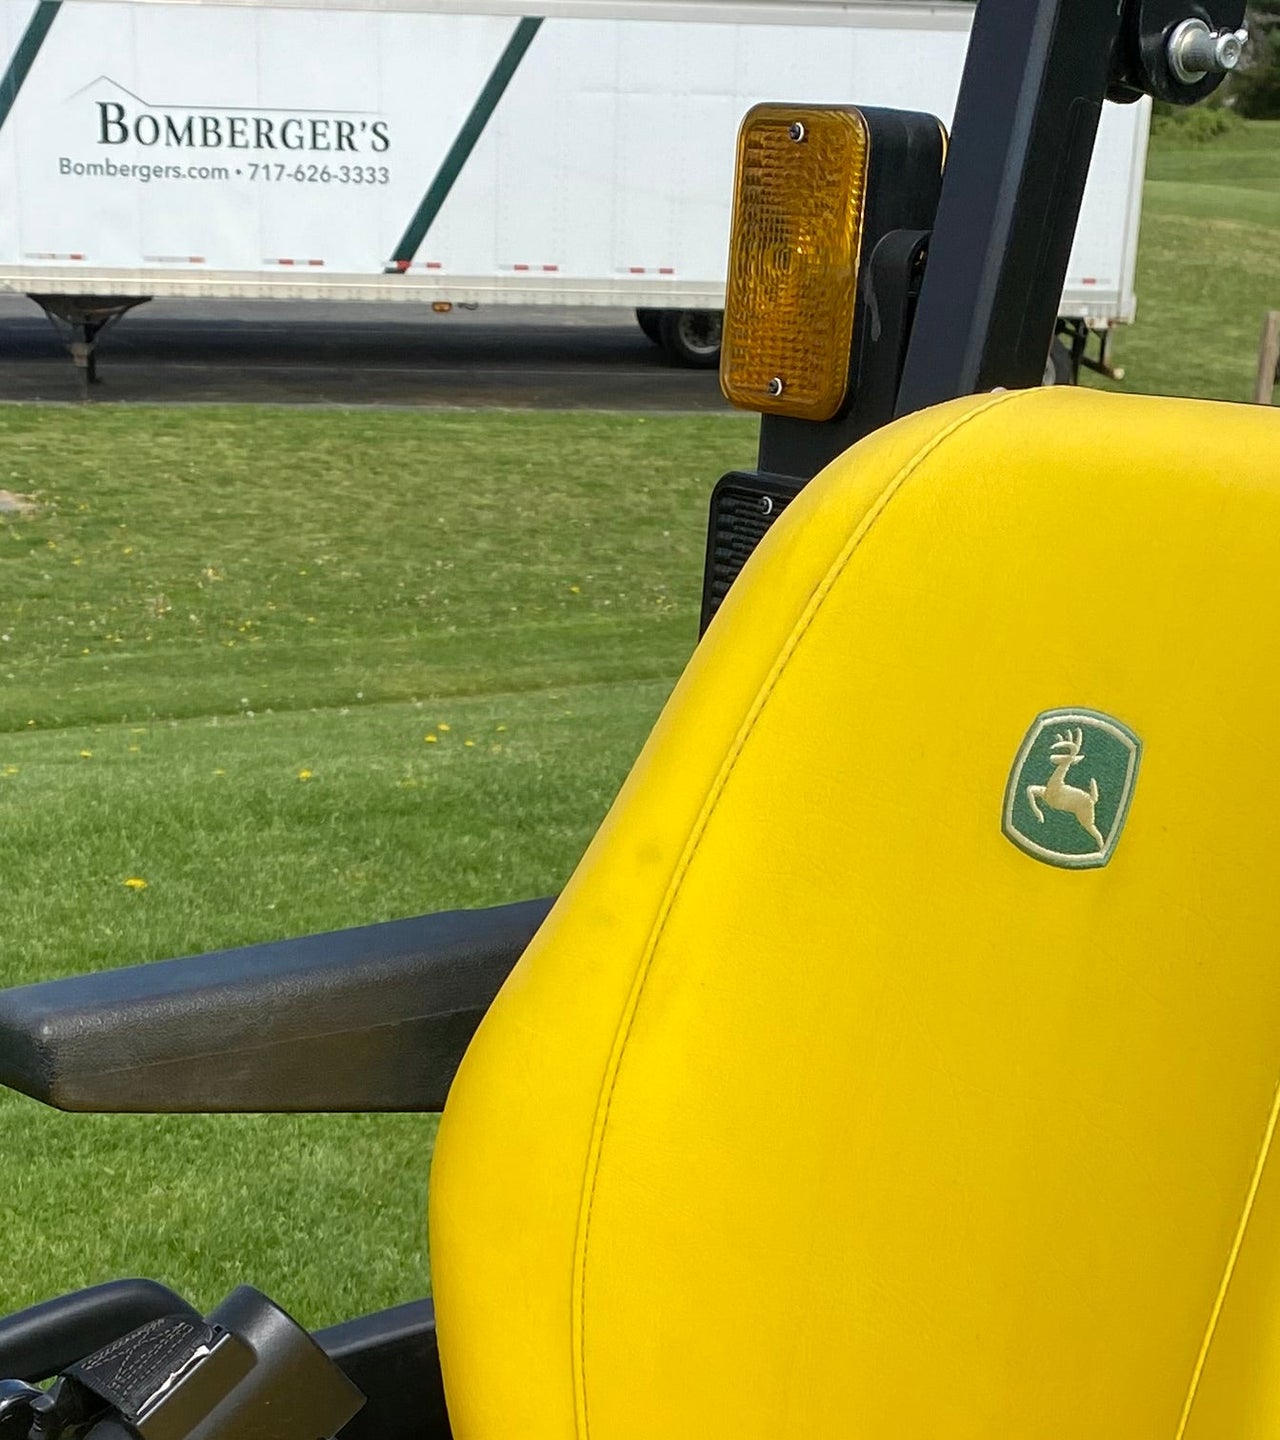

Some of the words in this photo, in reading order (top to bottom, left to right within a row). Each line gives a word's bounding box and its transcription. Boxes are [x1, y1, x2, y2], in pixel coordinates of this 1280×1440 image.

[94, 101, 391, 152] BOMBERGER'S
[59, 157, 229, 183] Bombergers.com
[248, 163, 390, 184] 717-626-3333
